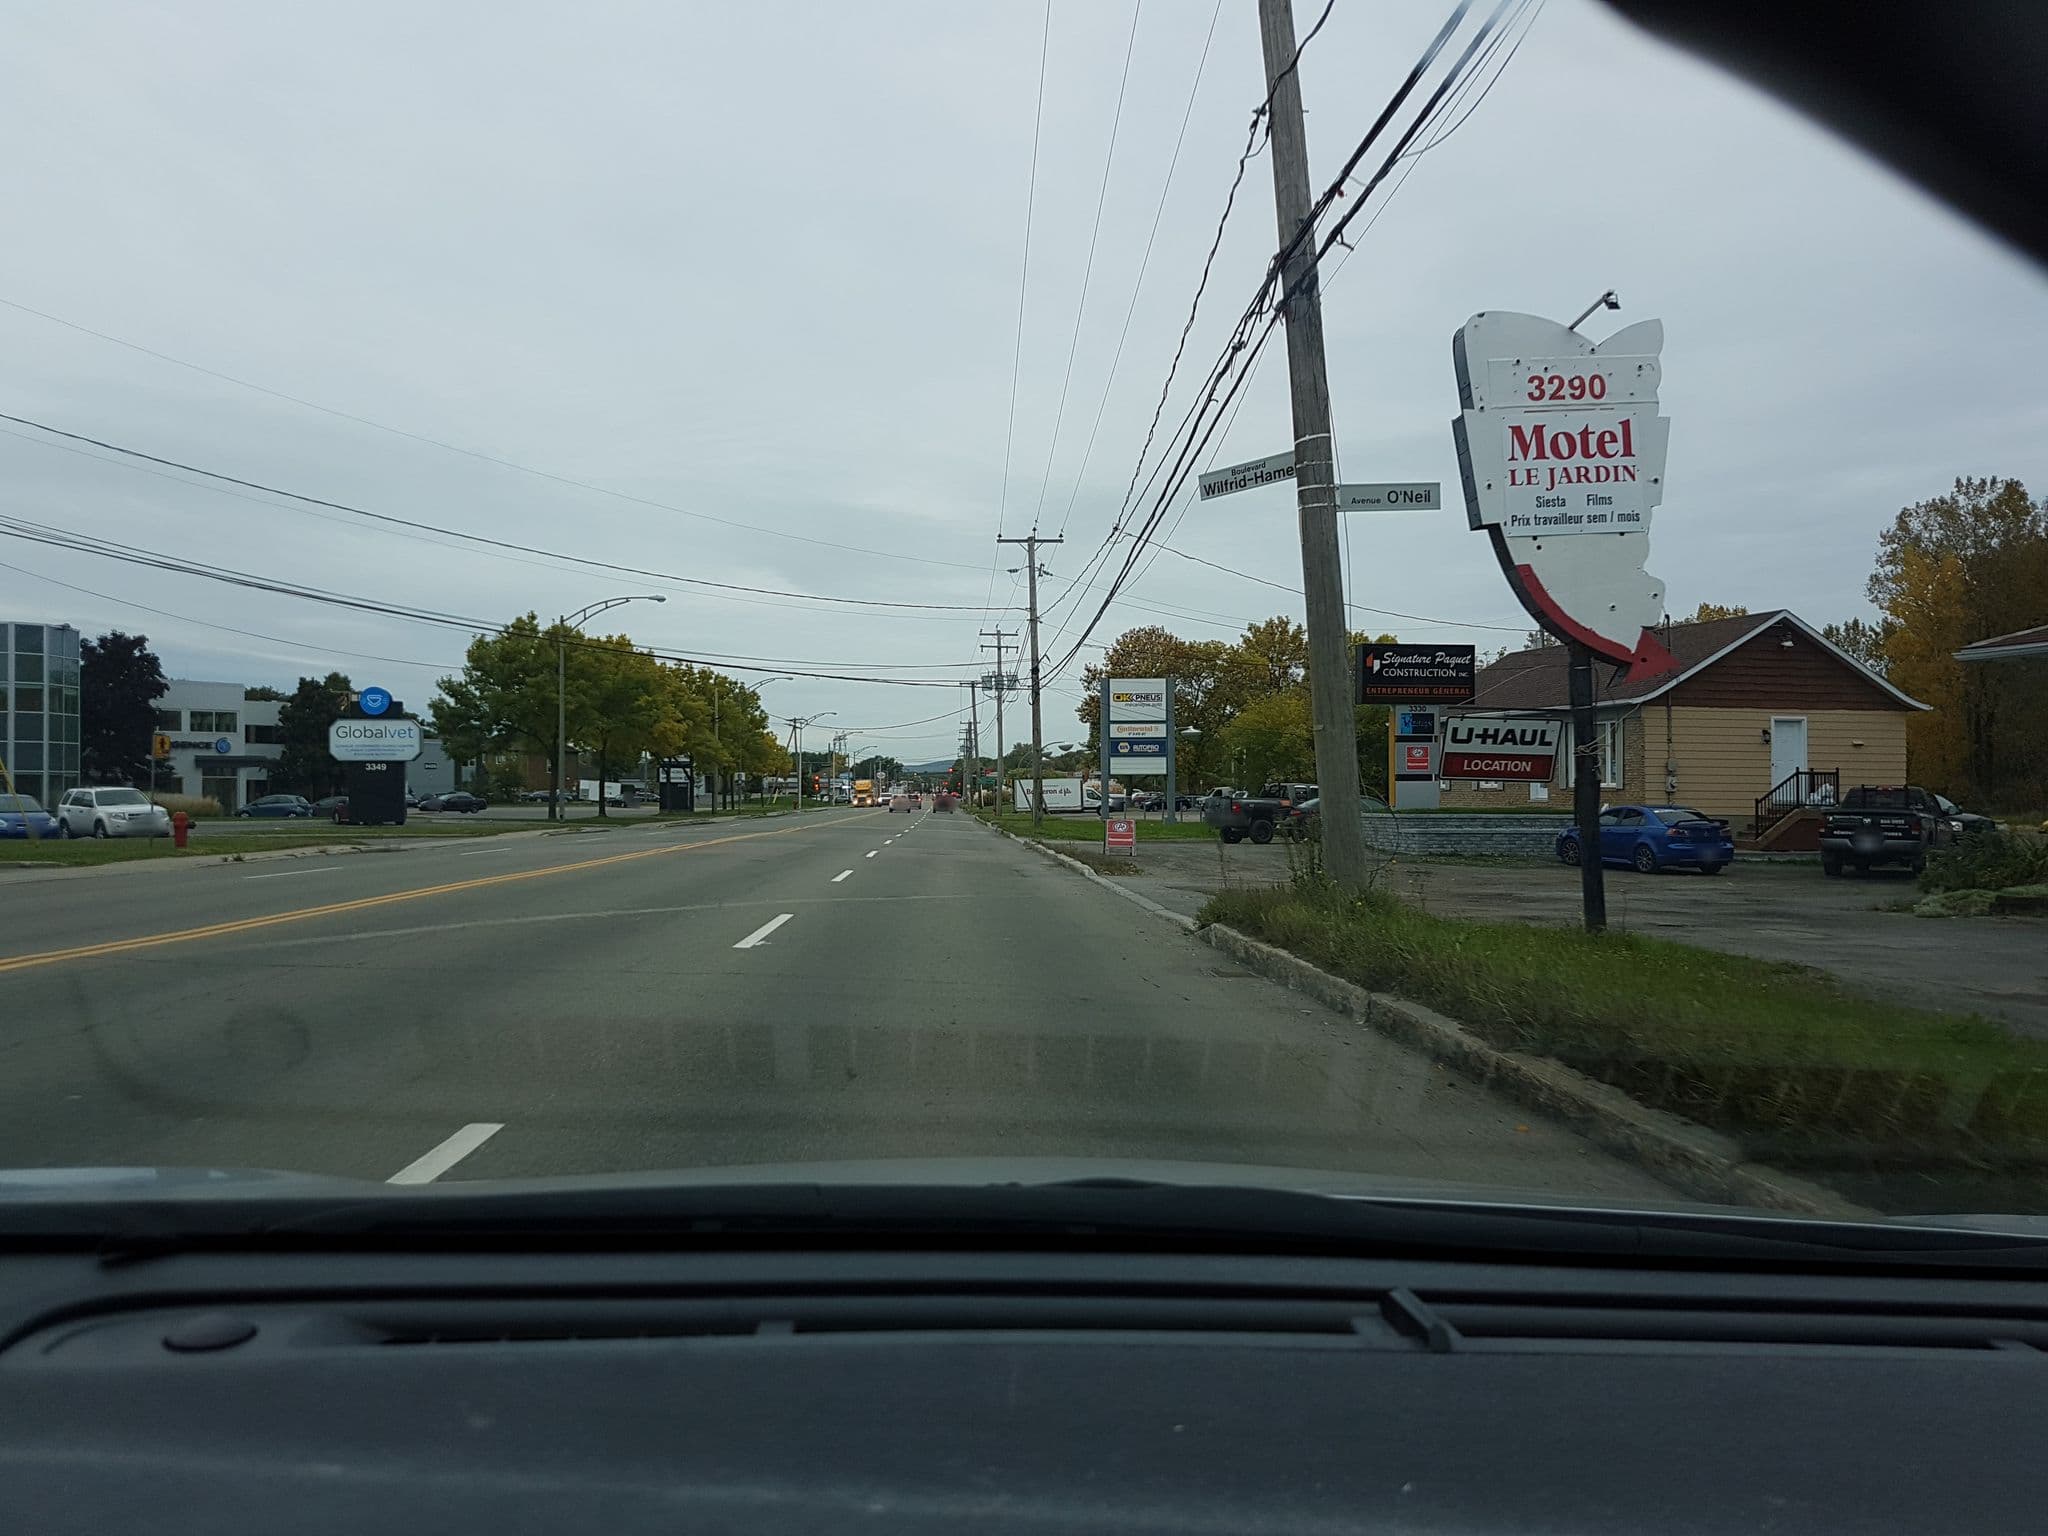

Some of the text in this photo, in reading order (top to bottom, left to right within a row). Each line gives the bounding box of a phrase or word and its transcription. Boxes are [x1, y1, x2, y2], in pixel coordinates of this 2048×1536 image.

[1527, 373, 1607, 402] 3290
[1507, 418, 1636, 462] Motel
[1231, 460, 1267, 477] Boulevard
[1203, 464, 1296, 497] Wilfrid-Hame
[1508, 464, 1638, 492] LE JARDIN
[1350, 489, 1432, 505] Avenue O'Neil
[1535, 493, 1613, 509] Siesta Films
[1510, 513, 1531, 527] Prix
[1533, 511, 1584, 526] travailleur
[1586, 512, 1608, 524] sem
[1616, 509, 1641, 523] mois
[1381, 651, 1472, 668] Signature Paquet
[1382, 668, 1457, 678] CONSTRUCTION
[1135, 692, 1162, 702] PNEUS
[1366, 687, 1431, 695] ENTREPRENEUR
[335, 725, 415, 739] Globalvet
[1450, 726, 1553, 747] U-HAUL
[365, 762, 388, 771] 3349
[1463, 759, 1533, 772] LOCATION
